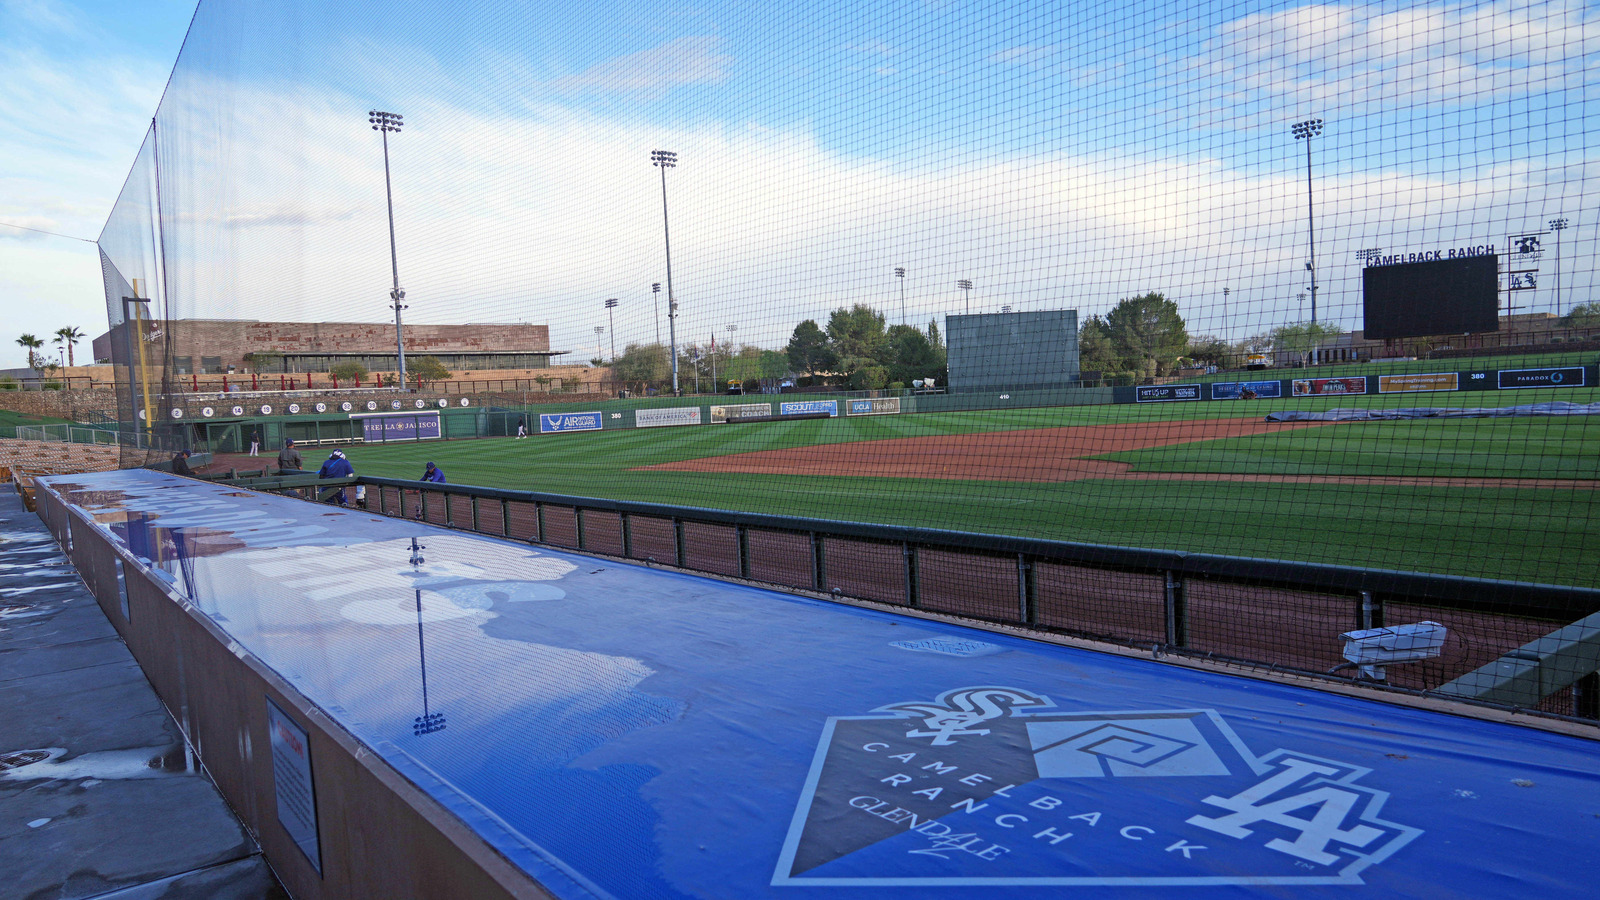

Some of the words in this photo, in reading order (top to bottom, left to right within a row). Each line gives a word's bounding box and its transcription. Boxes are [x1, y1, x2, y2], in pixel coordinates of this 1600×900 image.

[1366, 250, 1442, 268] CAMELBACK
[1449, 244, 1495, 258] RANCH
[405, 421, 437, 429] JAISCO
[563, 416, 578, 427] AIR
[873, 401, 895, 410] Health
[862, 742, 1208, 859] CAMELBACK
[881, 773, 1074, 845] RANCH
[1184, 757, 1386, 866] LA
[848, 795, 1011, 861] GLENDALE
